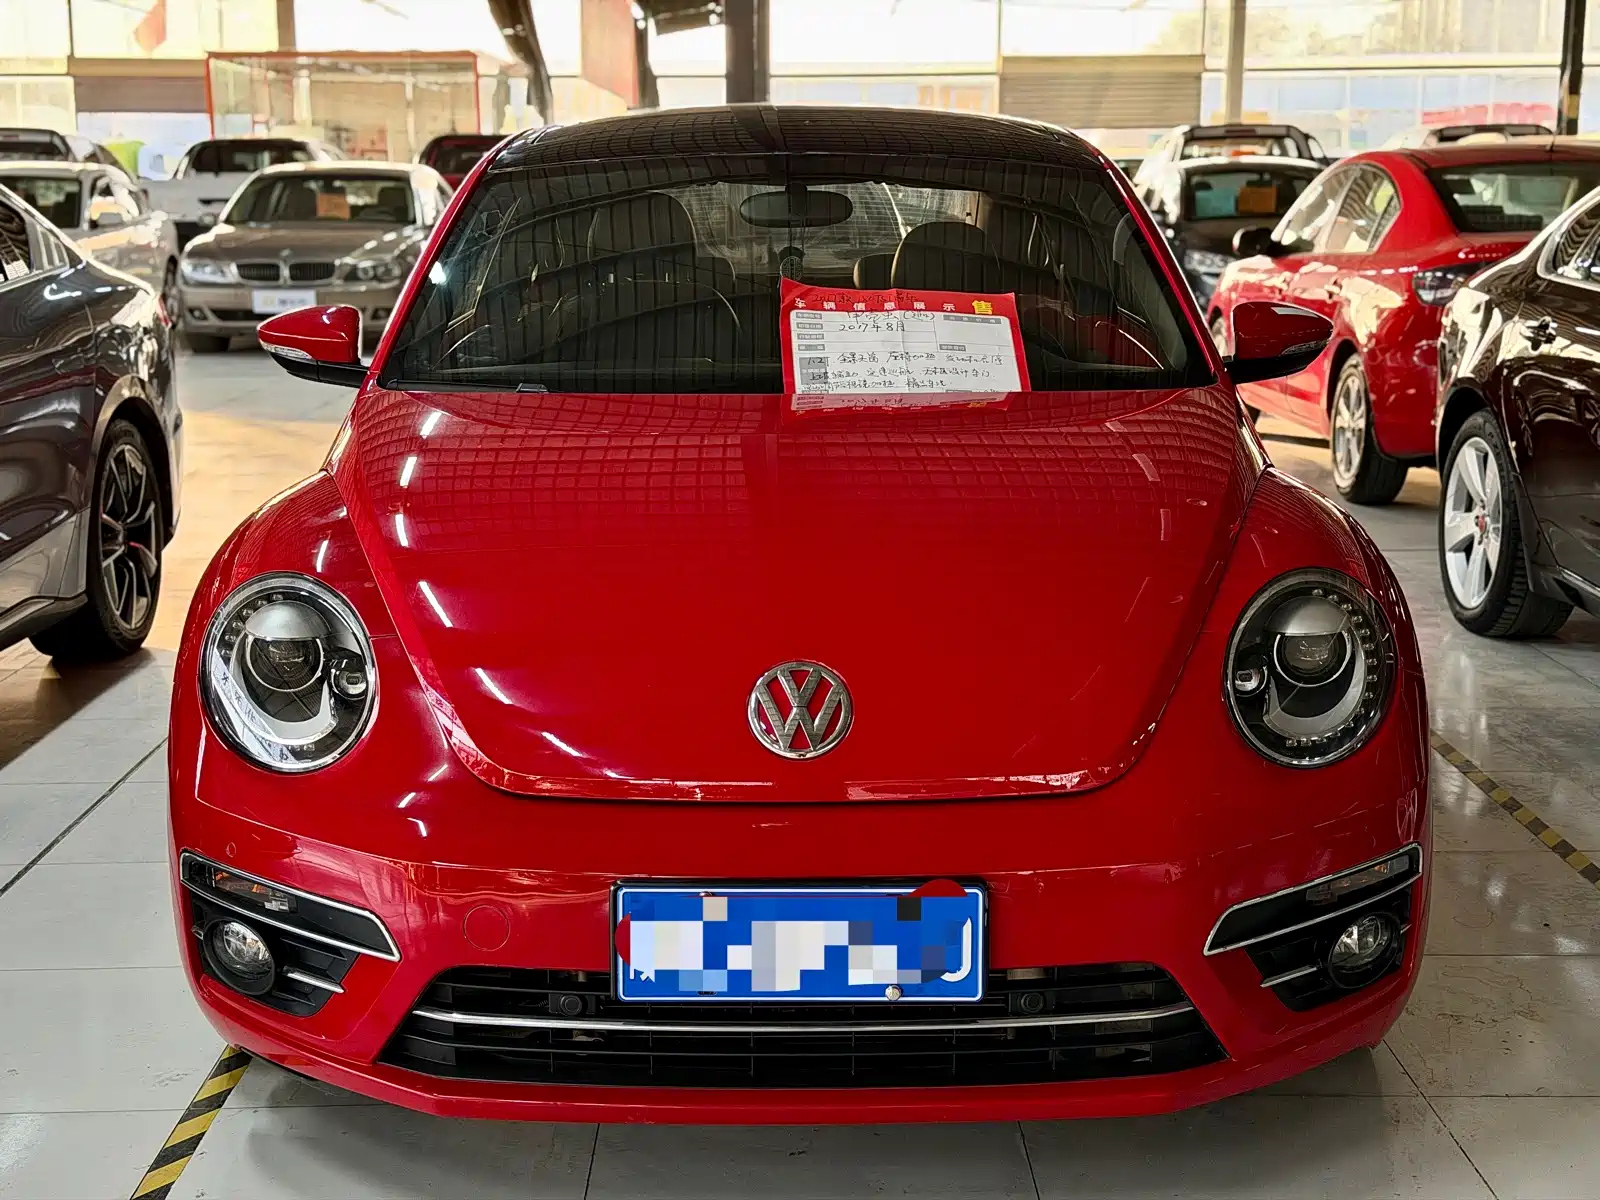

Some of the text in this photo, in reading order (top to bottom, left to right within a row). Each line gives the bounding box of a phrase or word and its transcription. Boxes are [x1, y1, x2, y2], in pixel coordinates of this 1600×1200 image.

[795, 297, 993, 315] 车辆信息展示 售
[839, 321, 905, 333] 2017年8月
